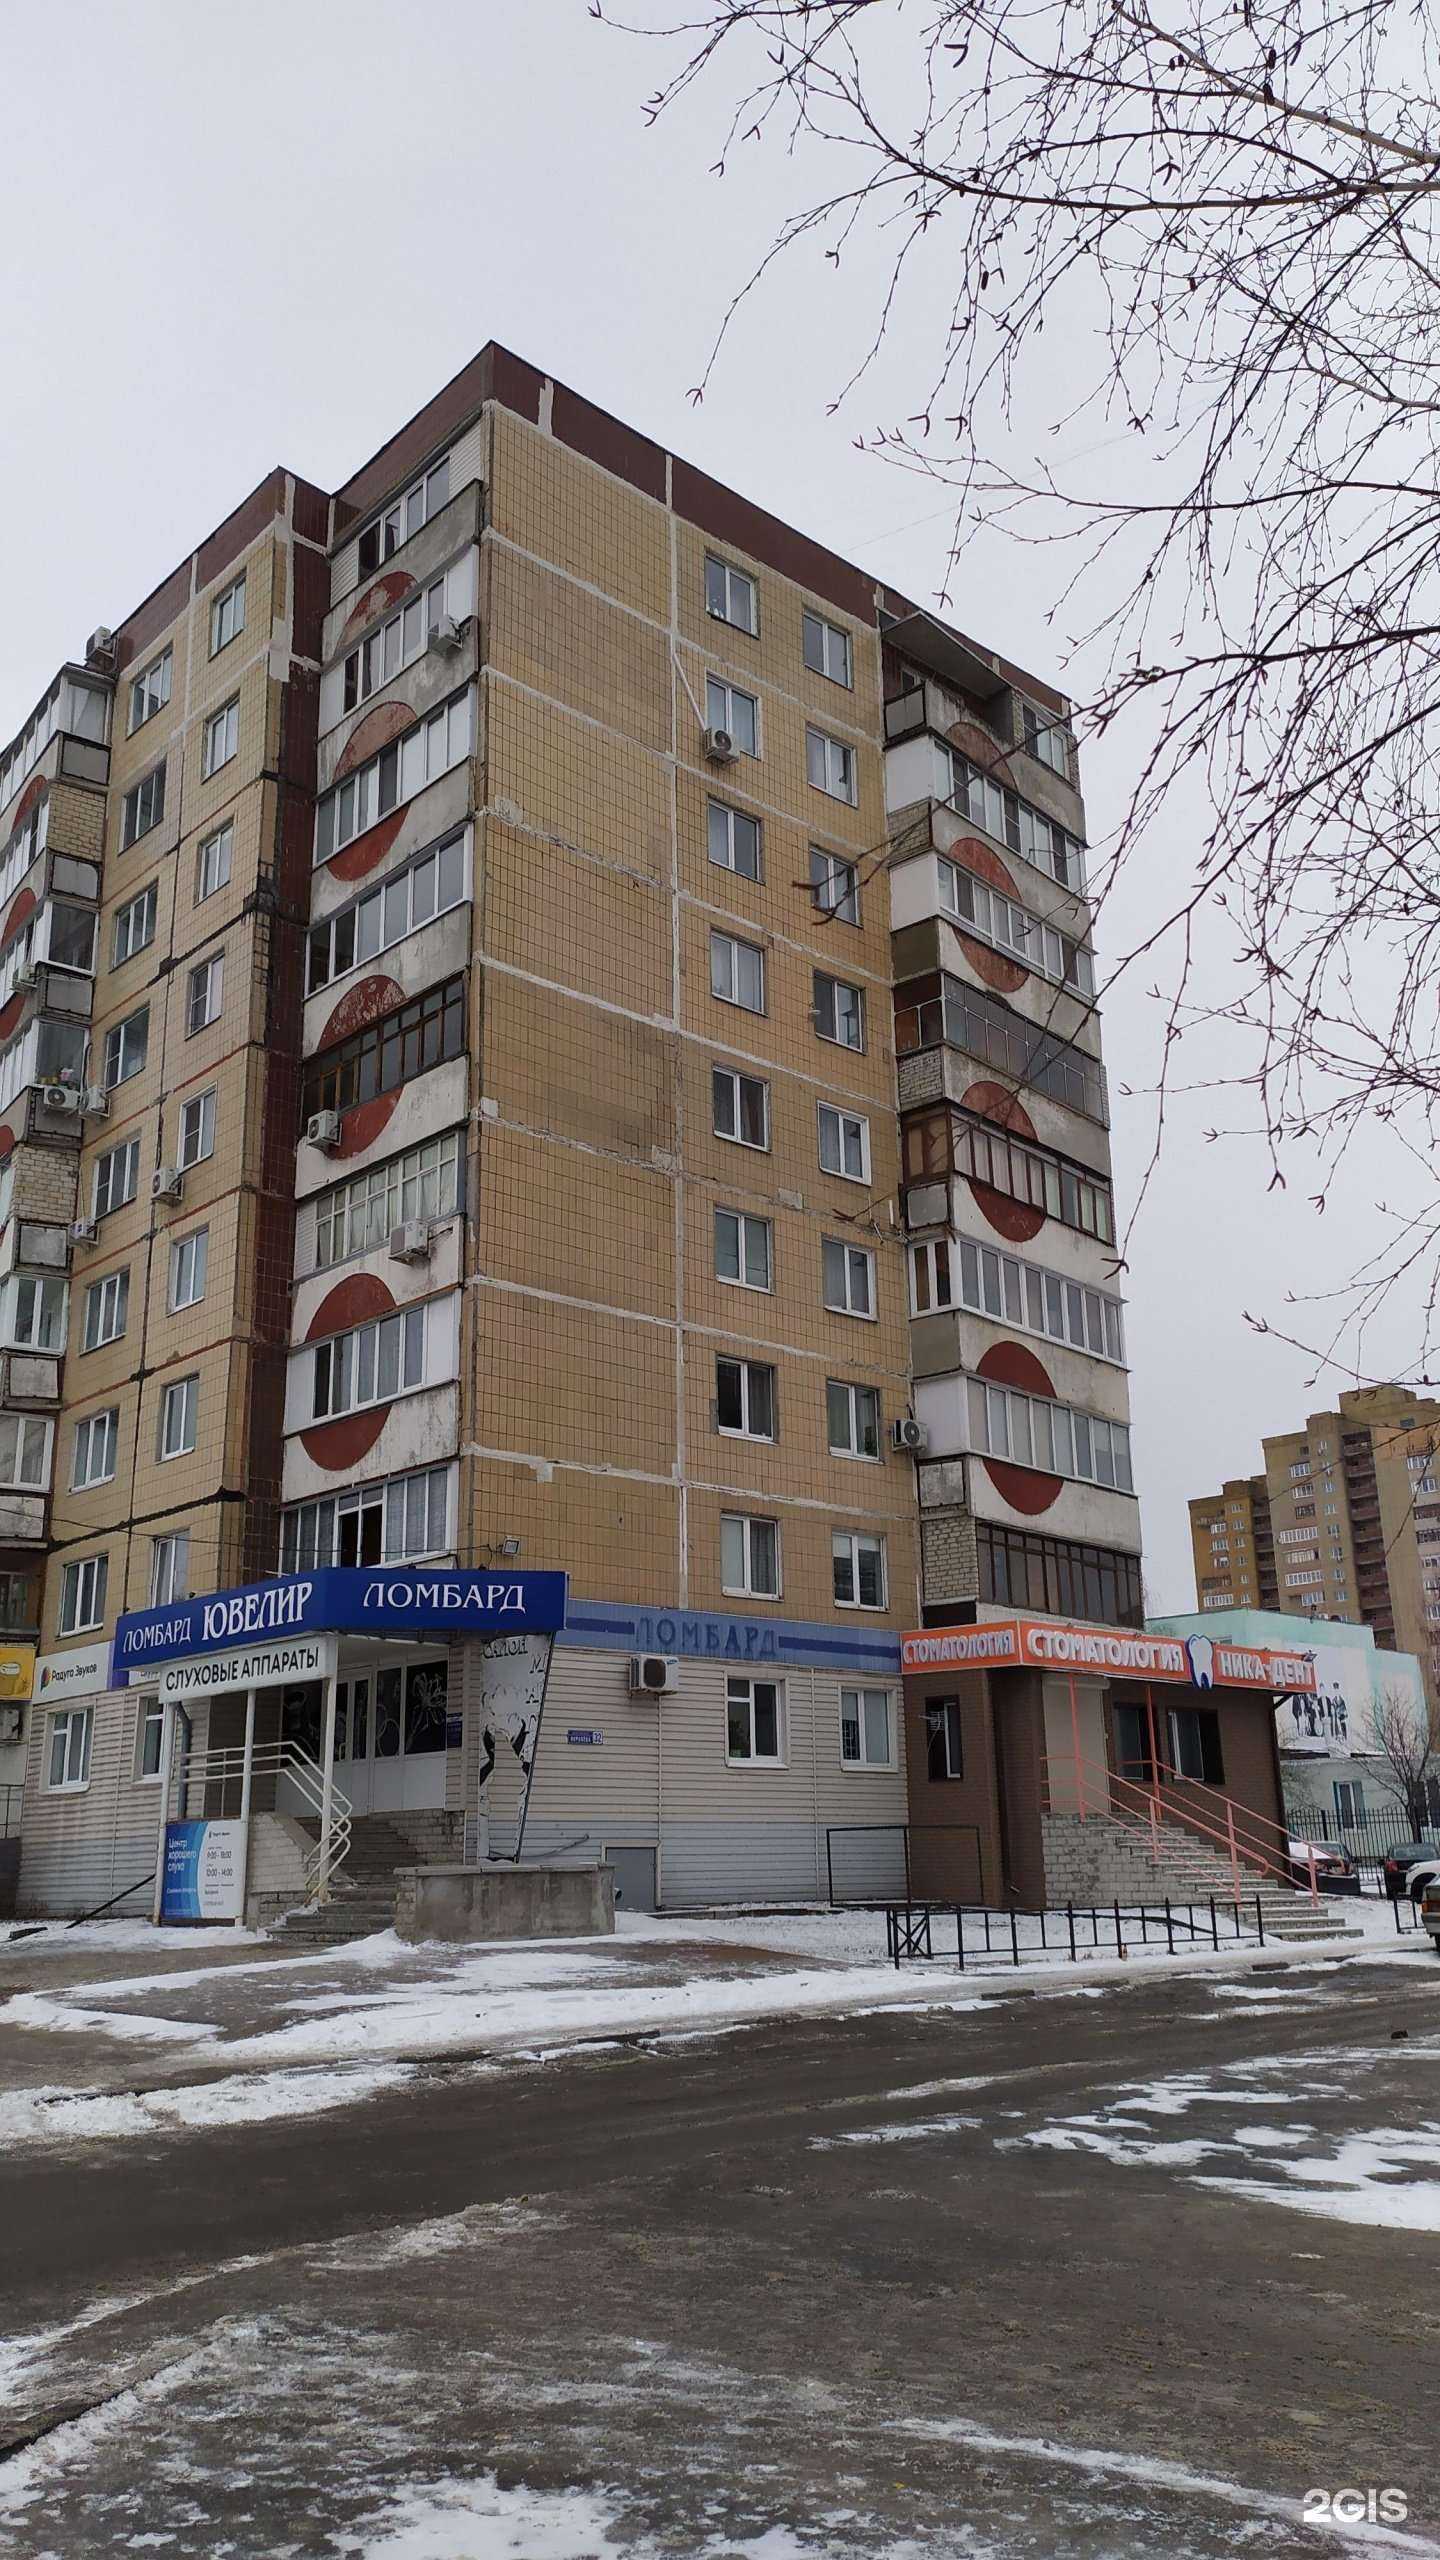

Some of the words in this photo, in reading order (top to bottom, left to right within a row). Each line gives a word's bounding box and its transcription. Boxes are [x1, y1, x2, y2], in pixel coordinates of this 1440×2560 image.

[123, 1617, 192, 1653] ЛОМБАРД
[201, 1582, 312, 1641] ЮВЕЛИР
[363, 1582, 526, 1616] ЛОМБАРД
[636, 1616, 777, 1657] ЛОМБАРД
[903, 1628, 1015, 1664] СТОМАТОЛОГИЯ
[51, 1667, 75, 1682] Радуга
[75, 1663, 98, 1679] Звуков
[166, 1660, 239, 1691] СЛУХОВЫЕ
[241, 1647, 319, 1679] АППАРАТЫ
[1027, 1629, 1185, 1672] СТОМАТОЛОГИЯ
[1220, 1650, 1313, 1687] НИКА-ДЕНТ
